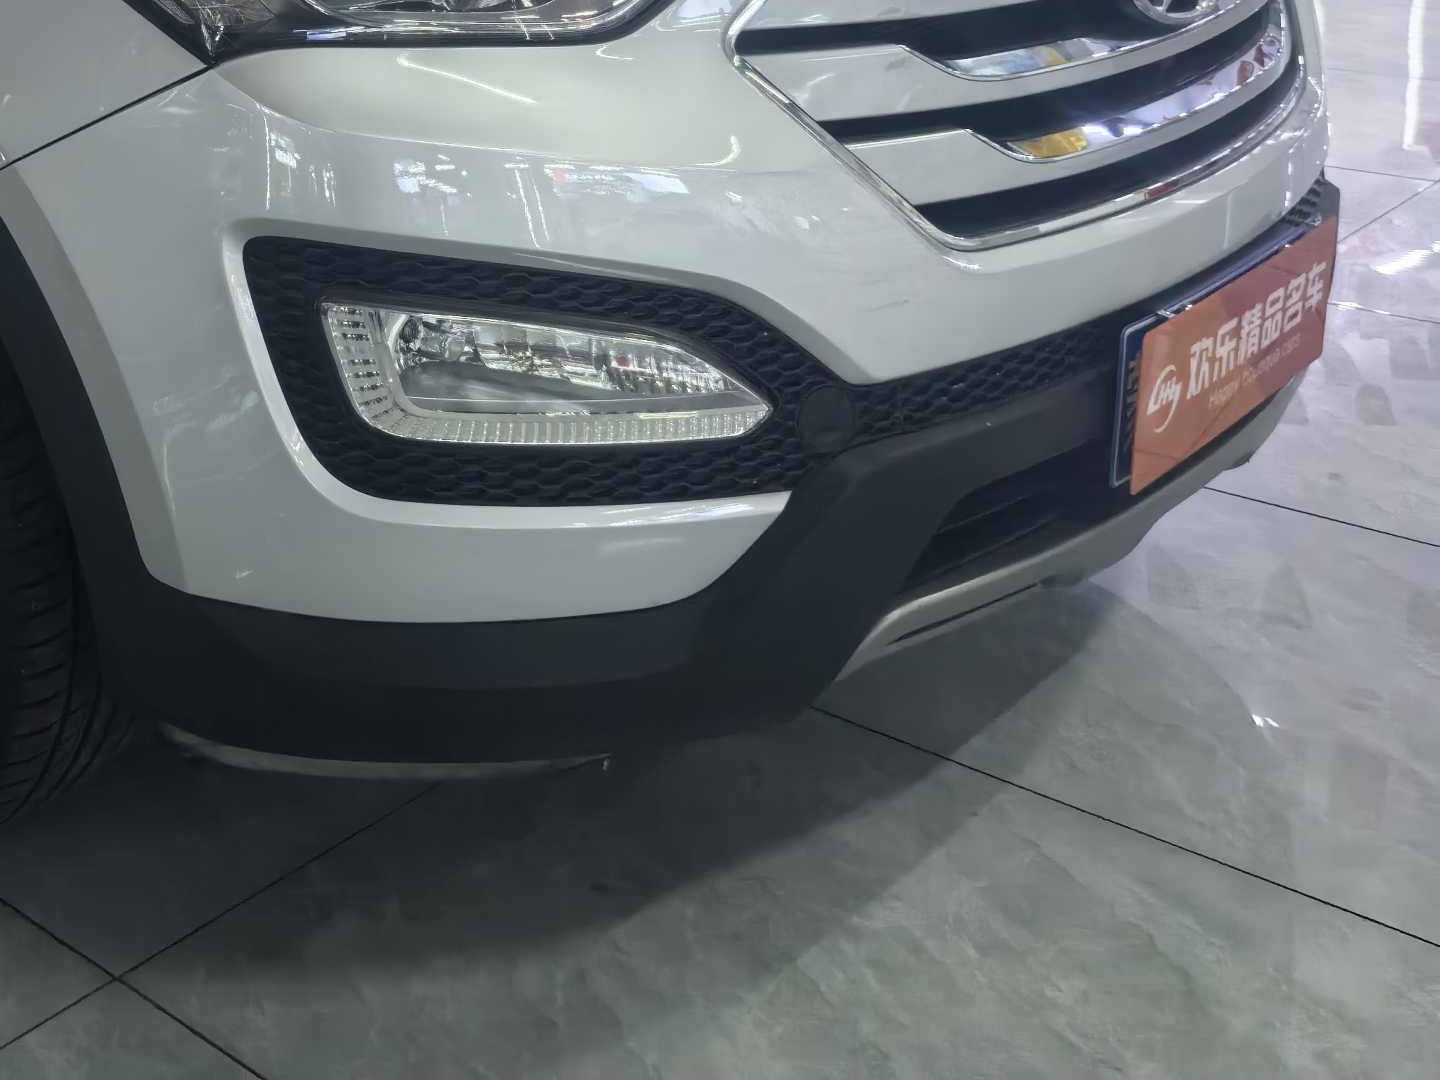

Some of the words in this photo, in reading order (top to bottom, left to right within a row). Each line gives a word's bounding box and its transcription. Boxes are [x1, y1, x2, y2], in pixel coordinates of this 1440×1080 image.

[1186, 262, 1327, 401] 欢乐精品名车
